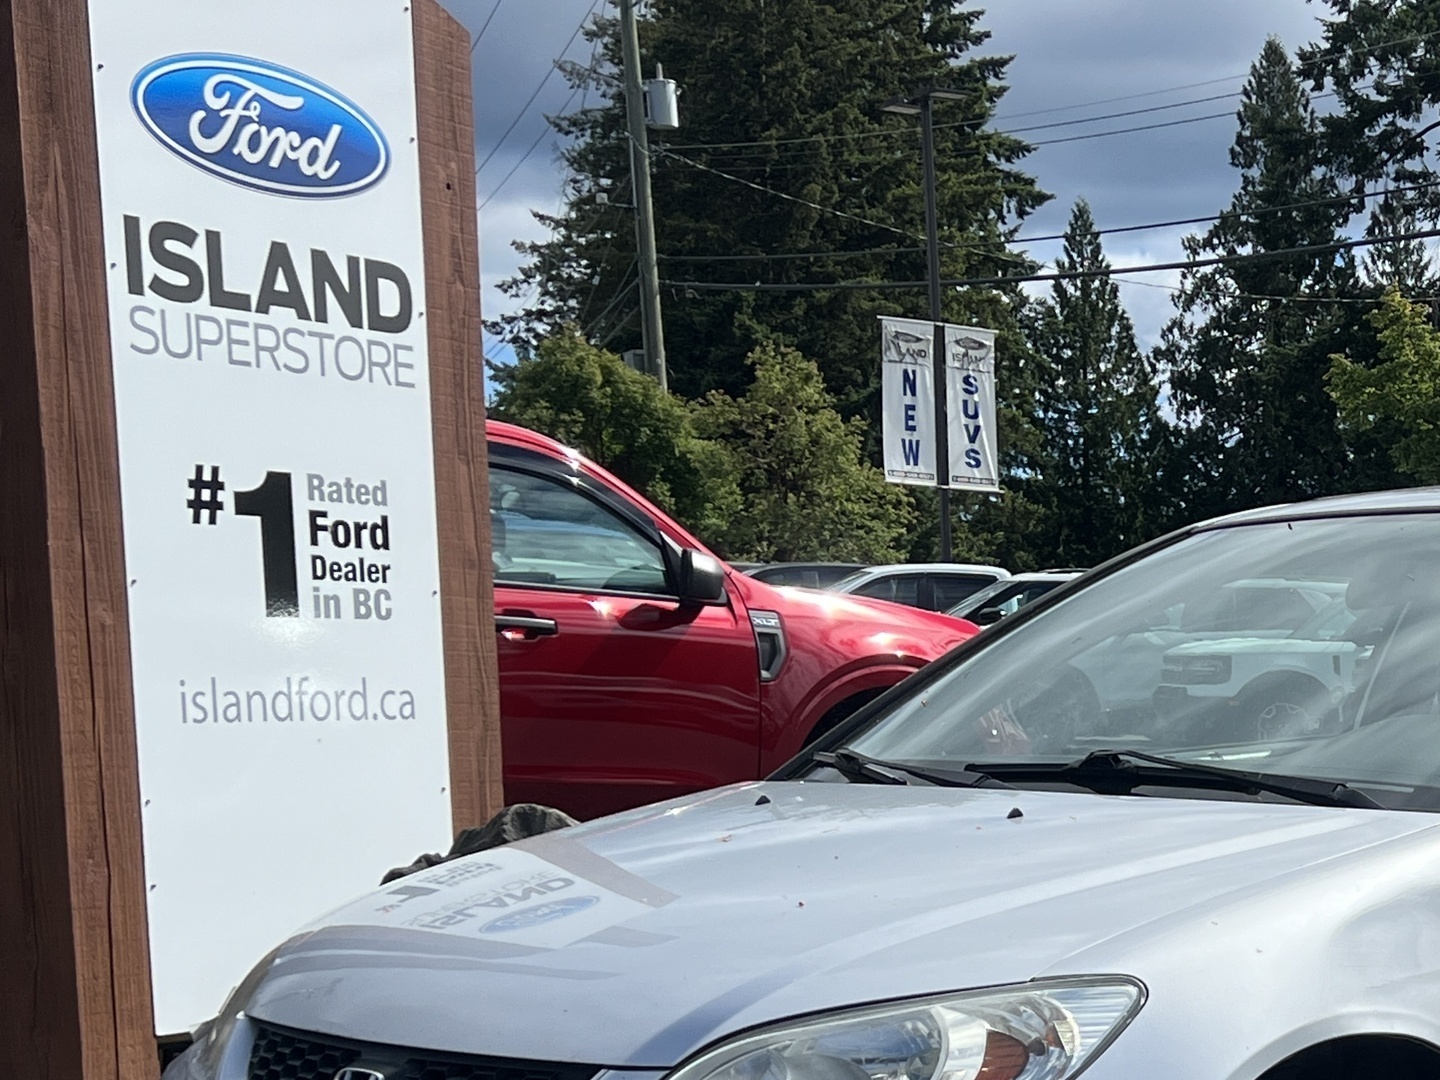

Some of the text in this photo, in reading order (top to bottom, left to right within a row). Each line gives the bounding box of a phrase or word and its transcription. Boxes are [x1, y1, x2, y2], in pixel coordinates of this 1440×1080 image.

[189, 73, 343, 179] Ford
[123, 214, 413, 334] ISLAND
[130, 305, 416, 388] SUPERSTORE
[902, 369, 920, 466] NEW
[962, 375, 982, 469] SUVS
[306, 473, 388, 507] Rated
[187, 464, 299, 618] #1
[308, 509, 390, 551] Ford
[310, 554, 391, 583] Dealer
[312, 586, 392, 620] in BC
[752, 616, 778, 626] XLT
[179, 676, 416, 723] islandford.ca
